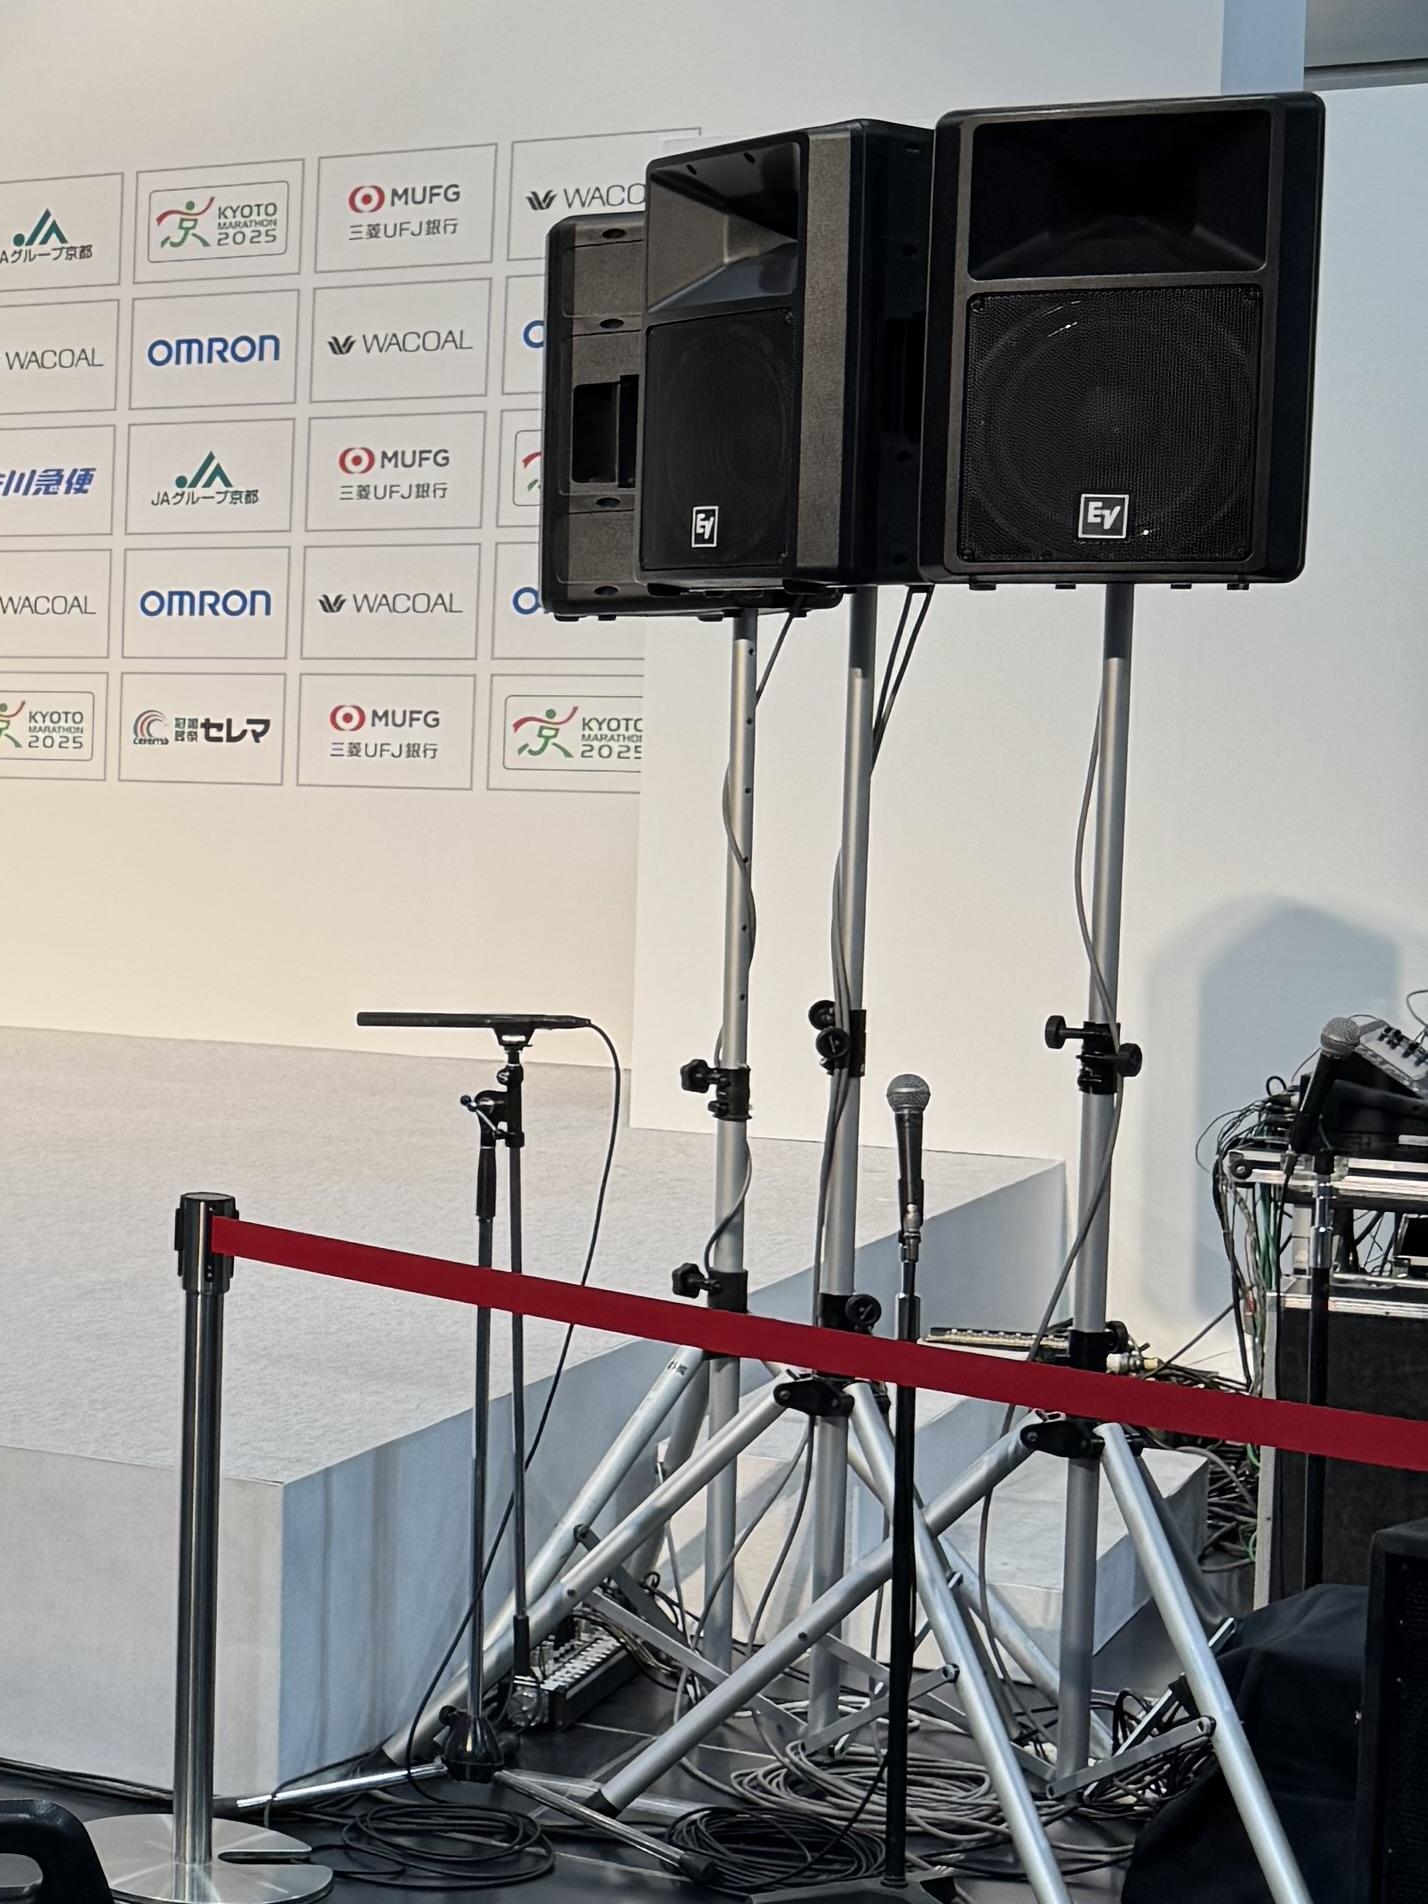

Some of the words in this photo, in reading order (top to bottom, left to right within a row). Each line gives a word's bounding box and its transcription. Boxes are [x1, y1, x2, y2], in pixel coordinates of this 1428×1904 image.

[391, 184, 460, 207] MUFG
[564, 183, 645, 208] WACO
[218, 202, 277, 220] KYOTO
[218, 218, 277, 230] MARATHON
[349, 218, 458, 240] 三菱UFJ銀行
[217, 228, 277, 246] 2025
[148, 335, 280, 366] OMRON
[362, 329, 473, 354] WACOAL
[5, 347, 104, 370] WACOAL
[381, 449, 449, 469] MUFG
[151, 489, 259, 506] JAグループ京都
[339, 482, 448, 500] 三菱UFJ銀行
[0, 595, 96, 615] WACOAL
[140, 590, 271, 616] OMRON
[352, 592, 463, 614] WACOAL
[29, 711, 83, 724] KYOTO
[371, 709, 440, 728] MUFG
[28, 726, 84, 734] MARATHON
[200, 718, 270, 743] セレマ
[28, 735, 83, 749] 2025
[330, 742, 438, 759] 三菱UFJ銀行
